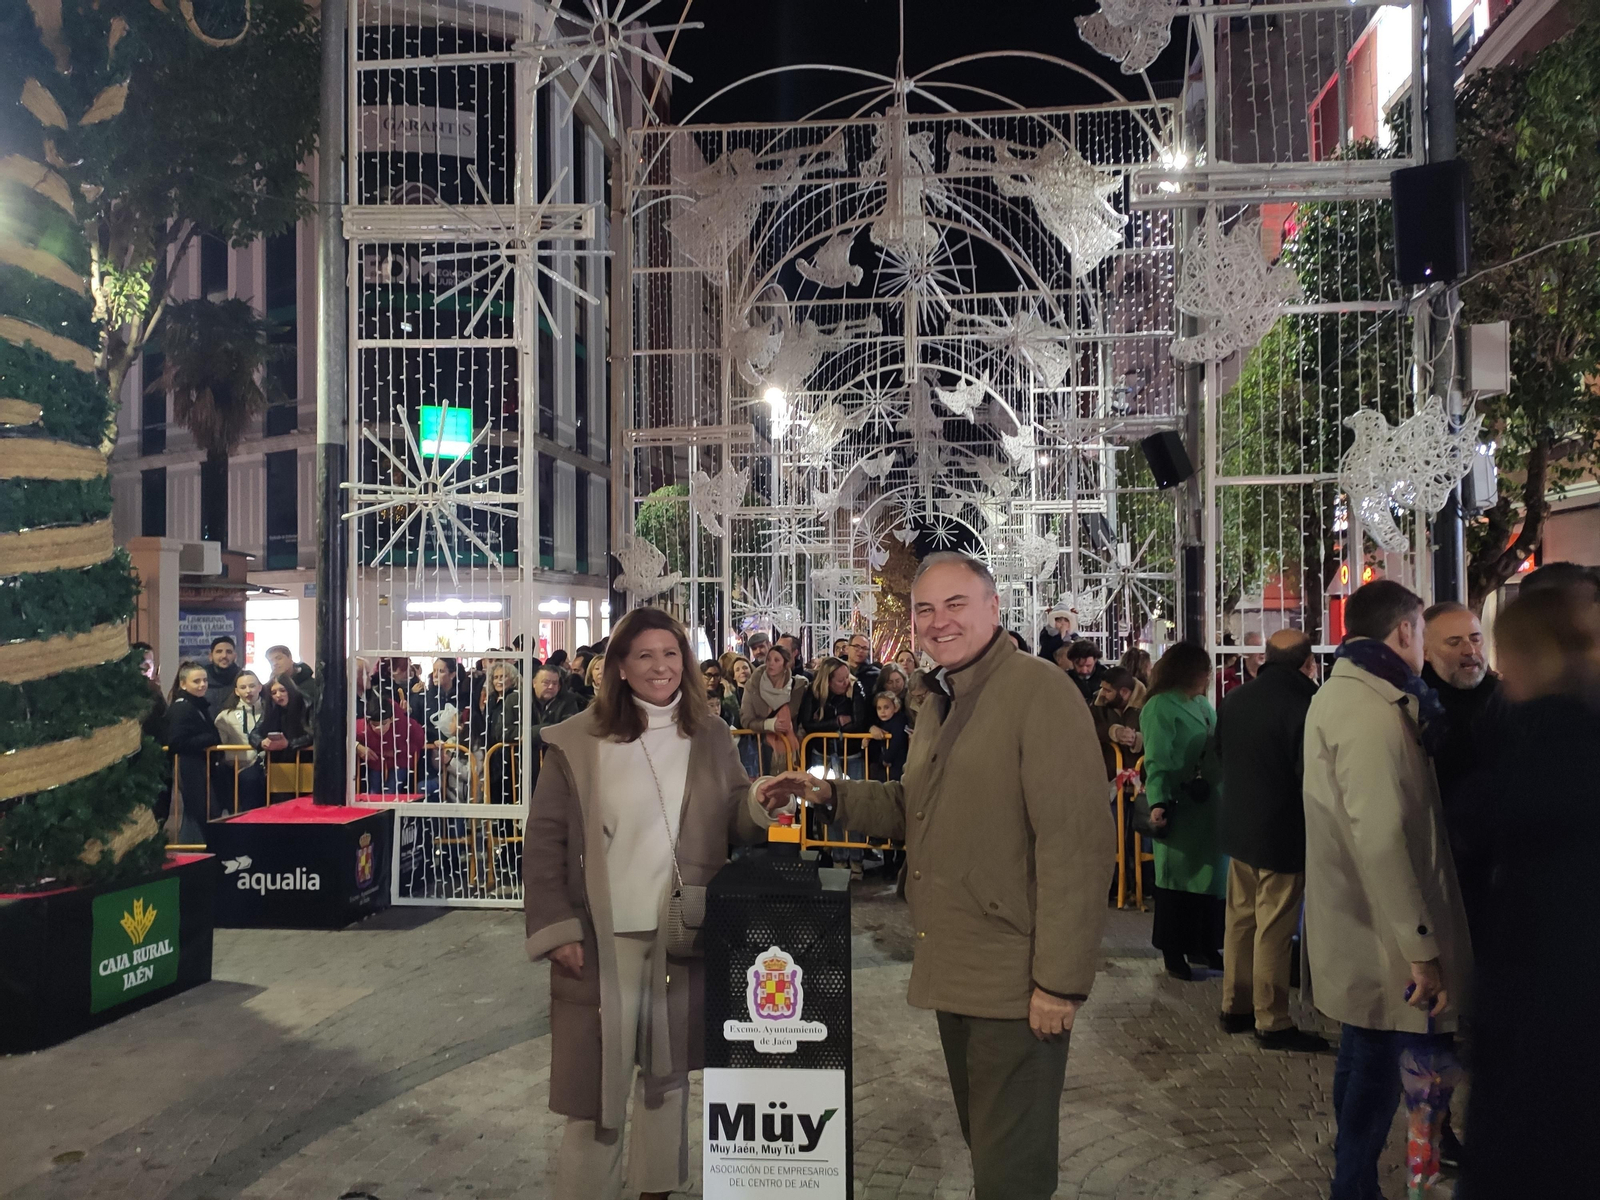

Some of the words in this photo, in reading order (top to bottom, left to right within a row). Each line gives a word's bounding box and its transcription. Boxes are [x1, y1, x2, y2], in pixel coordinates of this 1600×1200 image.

[236, 866, 320, 896] aqualia
[98, 953, 131, 976] CAJA
[132, 939, 174, 966] RURAL
[122, 965, 154, 991] JAÉN
[729, 1025, 761, 1034] Excmo.
[763, 1025, 823, 1036] Ayuntamiento
[759, 1038, 770, 1046] de
[772, 1037, 792, 1046] Jaén
[708, 1101, 839, 1153] Müy
[709, 1143, 730, 1155] Muy
[732, 1143, 759, 1155] Jaén,
[761, 1144, 782, 1156] Muy
[784, 1143, 796, 1155] Tú
[710, 1164, 761, 1175] ASOCIACIÓN
[763, 1166, 775, 1175] DE
[777, 1166, 839, 1176] EMPRESARIOS
[729, 1178, 746, 1187] DEL
[748, 1178, 783, 1188] CENTRO
[785, 1179, 797, 1188] DE
[799, 1178, 820, 1189] JAÉN
